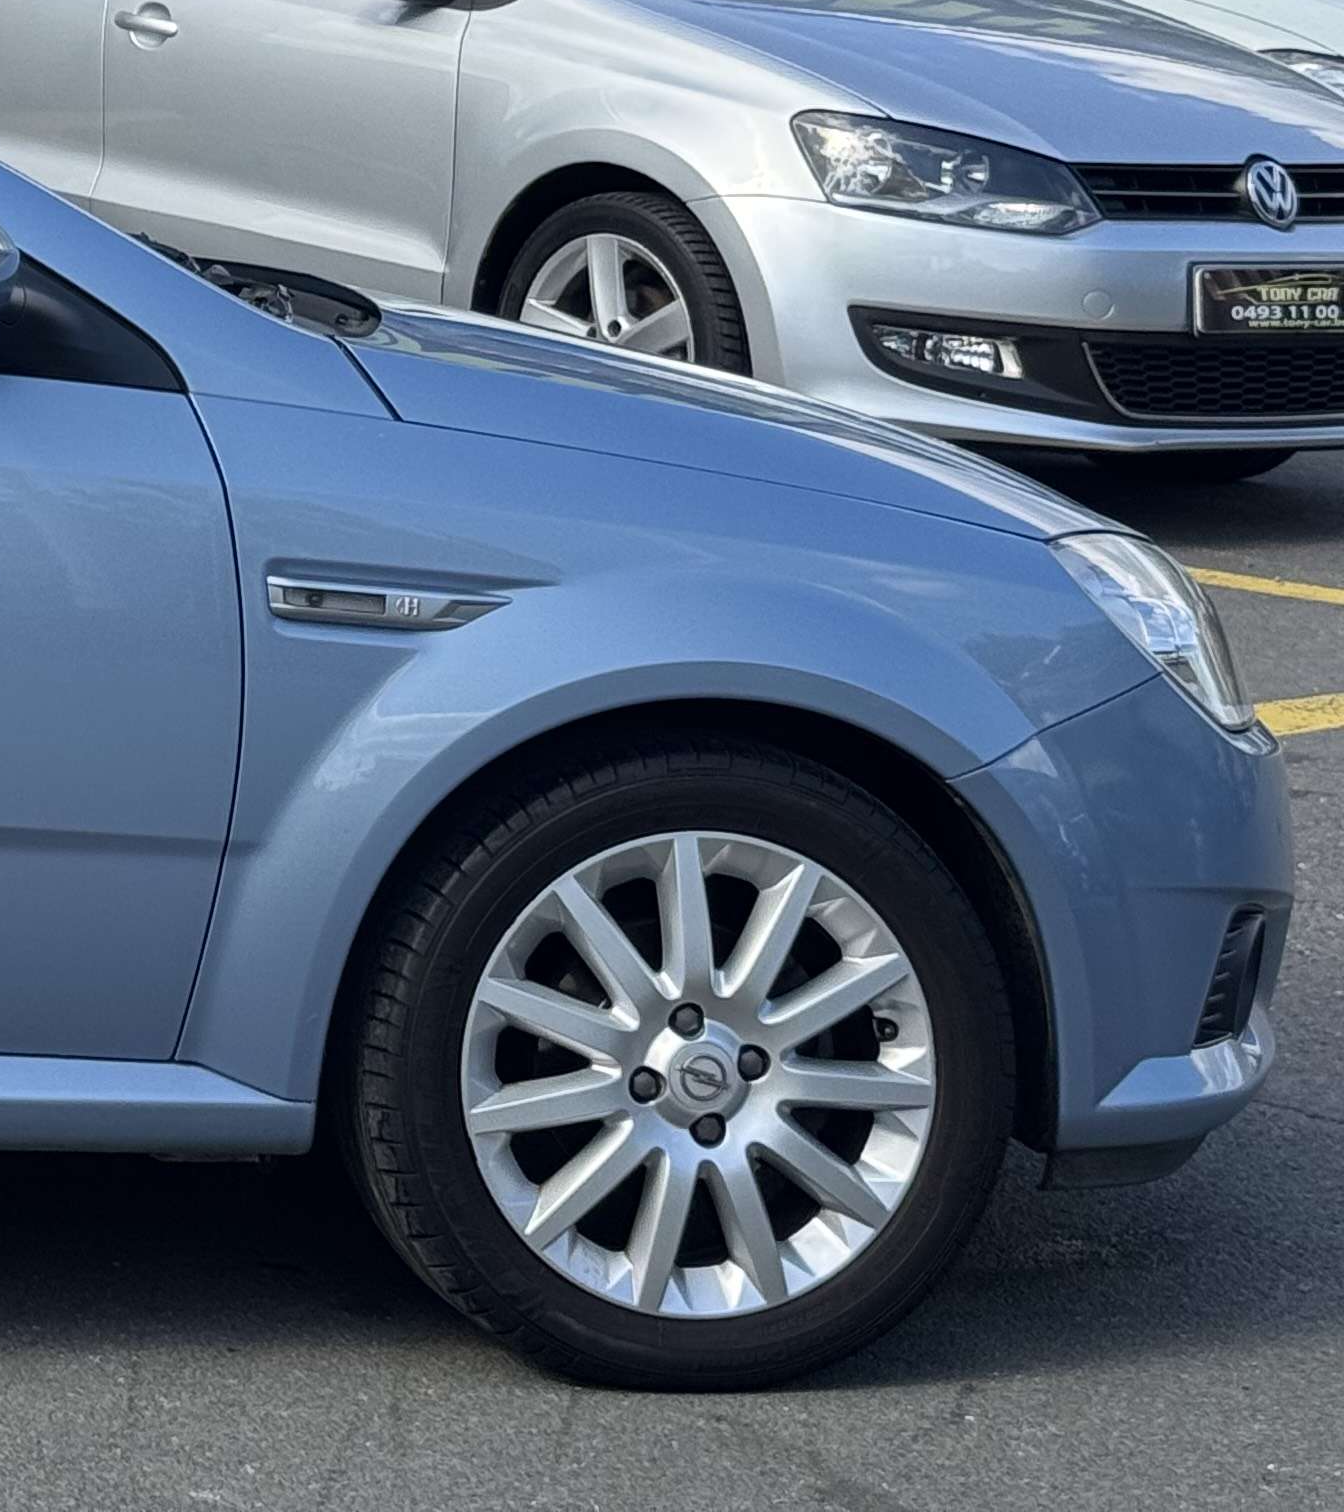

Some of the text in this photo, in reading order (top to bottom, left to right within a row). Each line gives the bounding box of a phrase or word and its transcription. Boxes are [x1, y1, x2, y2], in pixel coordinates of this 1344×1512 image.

[1231, 305, 1339, 320] 0493 11 00
[1248, 317, 1344, 329] www.tony-car.b
